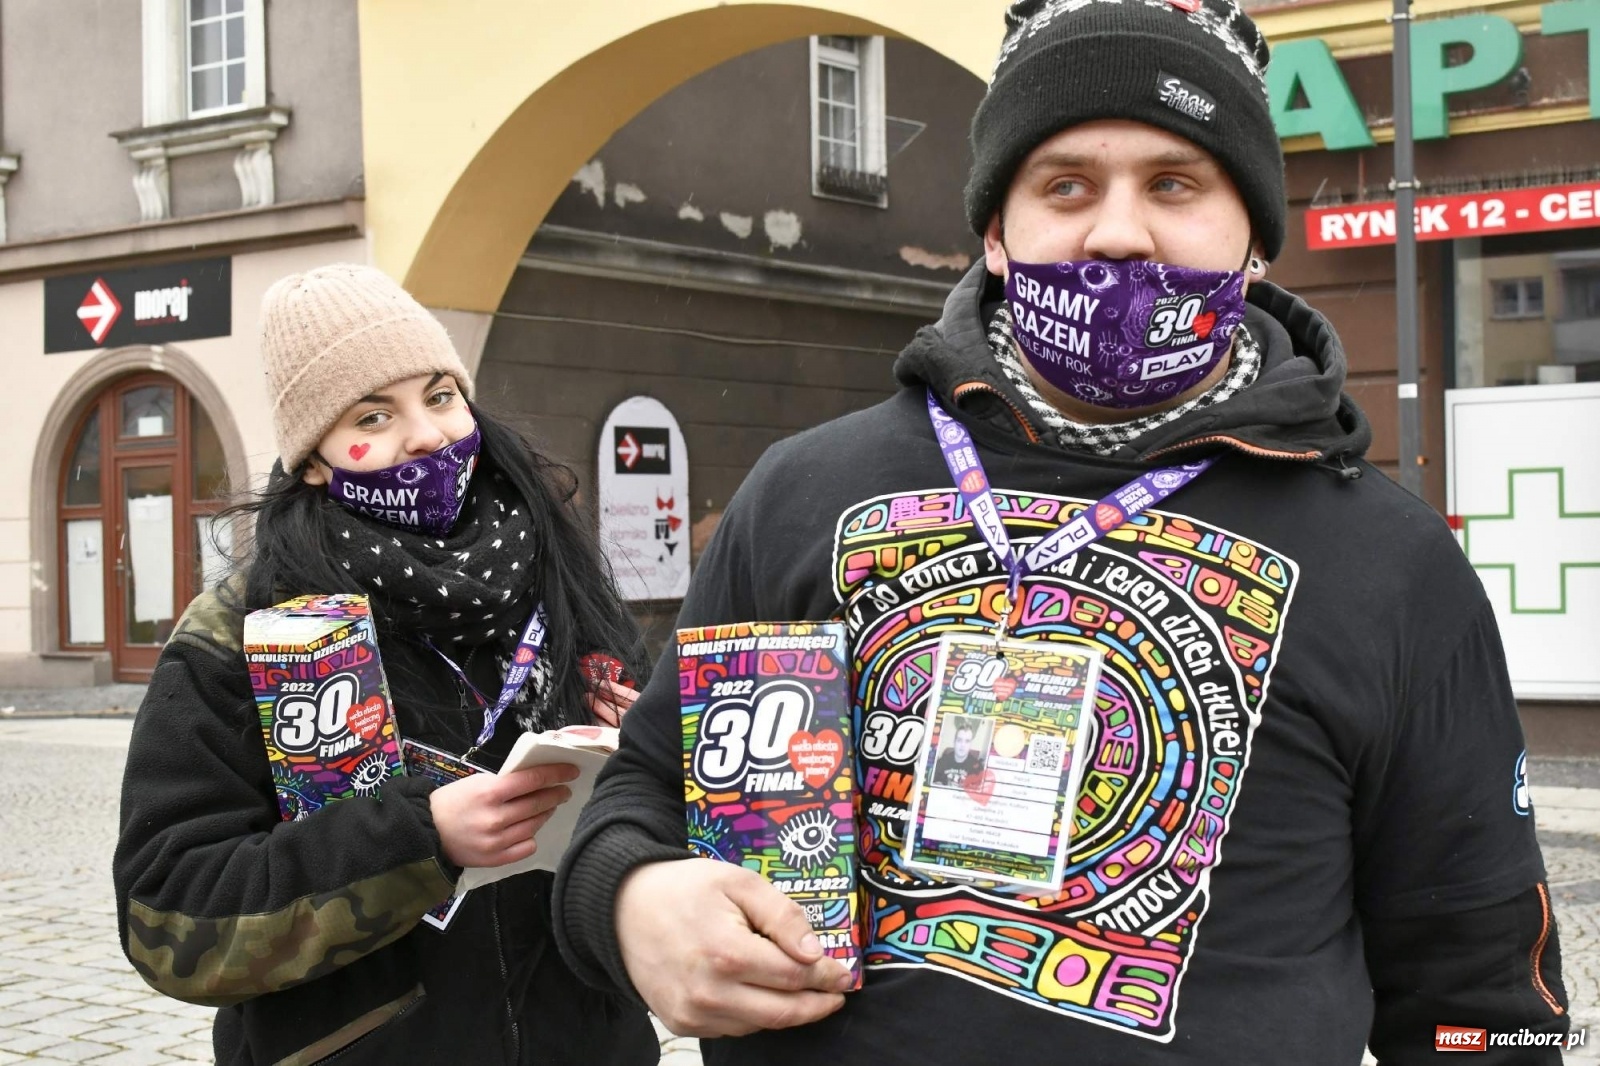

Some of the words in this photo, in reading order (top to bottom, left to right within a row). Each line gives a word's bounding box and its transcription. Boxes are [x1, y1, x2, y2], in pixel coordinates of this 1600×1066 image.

[1320, 204, 1449, 242] RYNK
[1459, 198, 1507, 230] 12
[1539, 189, 1600, 222] CE
[134, 278, 190, 322] moraj
[1014, 272, 1100, 326] GRAMY
[1147, 296, 1203, 346] 30
[1155, 296, 1180, 306] 2022
[1013, 301, 1091, 359] RAZEM
[1016, 329, 1063, 365] KOLEJNY
[1065, 355, 1093, 377] ROK
[1146, 348, 1209, 375] PLAY
[342, 481, 420, 507] GRAMY
[976, 498, 1006, 546] PLAY
[1034, 524, 1089, 565] PLAY
[1080, 555, 1098, 581] i
[1094, 561, 1170, 618] jeden
[251, 653, 312, 663] OKULISTYKI
[682, 637, 756, 657] OKULISTYKI
[280, 682, 316, 693] 2022
[711, 679, 755, 697] 2022
[951, 657, 1007, 694] 30
[277, 676, 356, 750] 30
[698, 685, 809, 784] 30
[862, 713, 926, 763] 30
